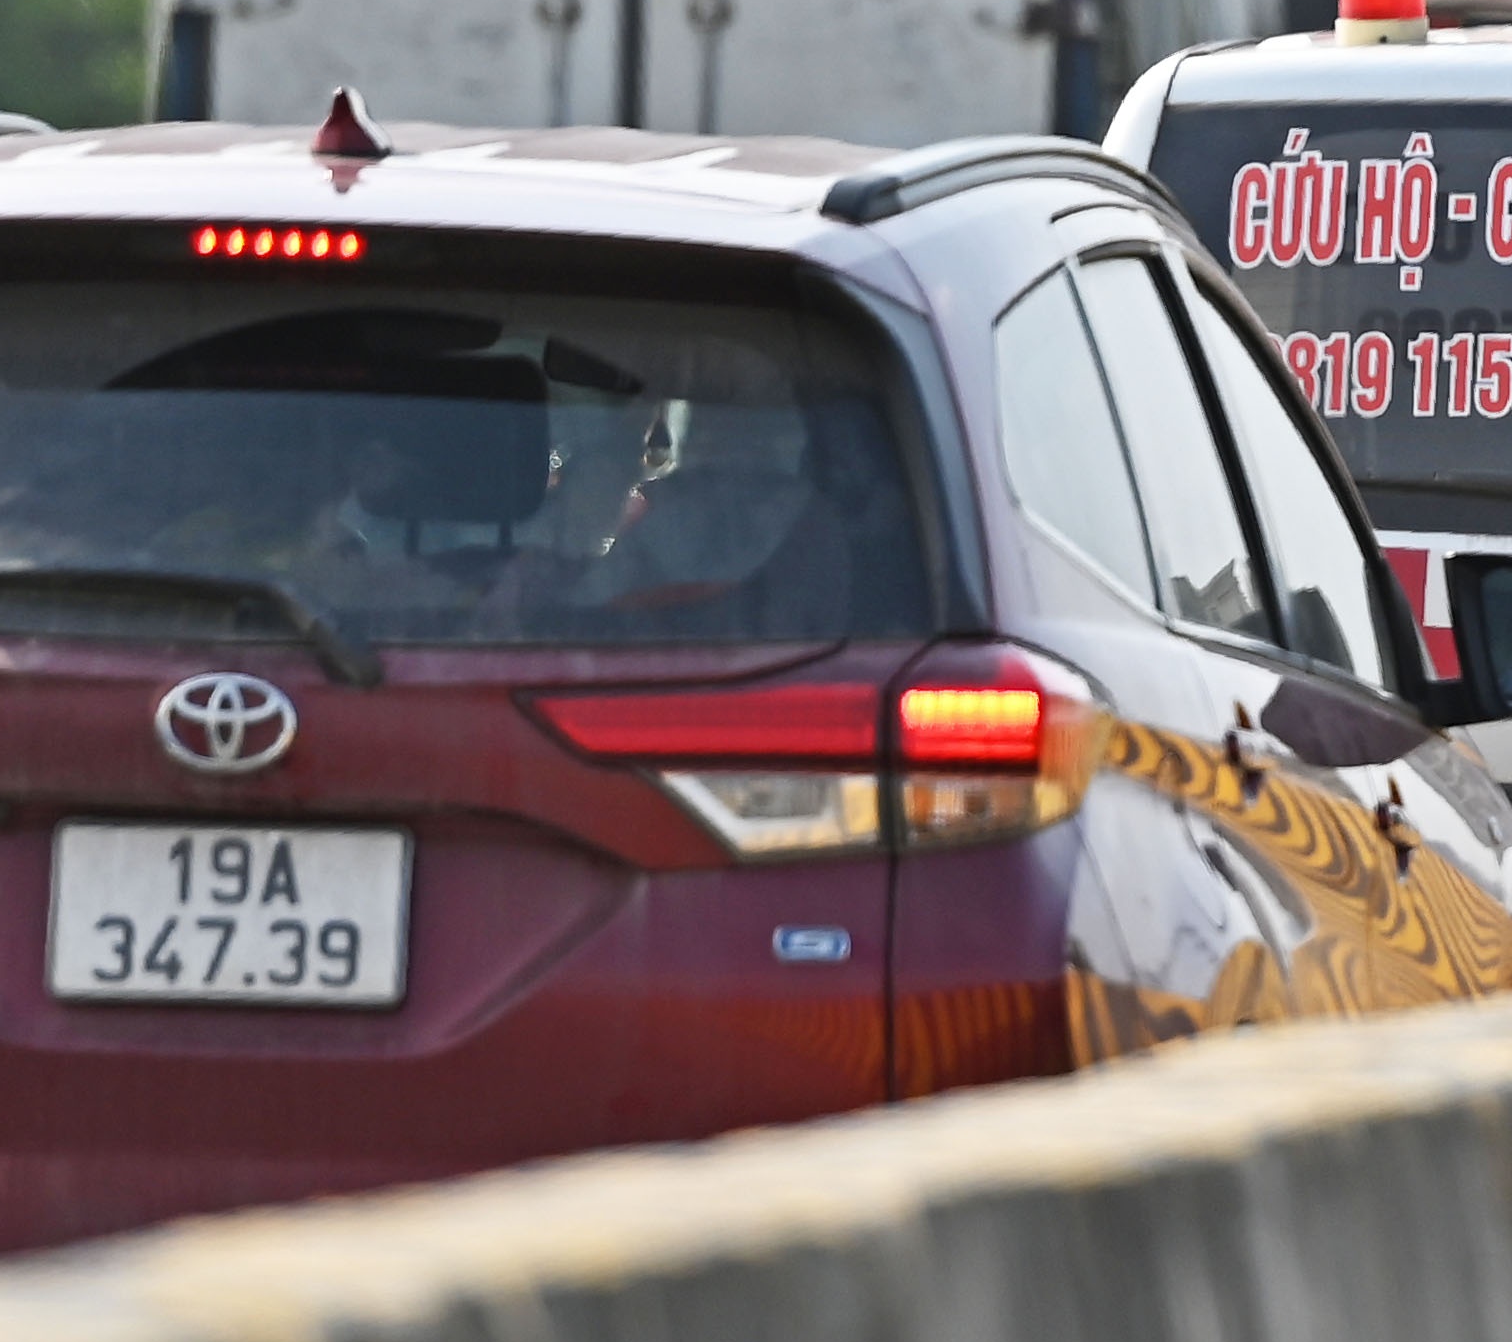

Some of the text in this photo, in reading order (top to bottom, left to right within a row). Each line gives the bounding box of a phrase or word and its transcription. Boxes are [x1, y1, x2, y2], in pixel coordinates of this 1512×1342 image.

[1229, 126, 1348, 269] CỨU
[1354, 131, 1437, 291] HỘ
[1448, 192, 1477, 221] -
[1265, 331, 1394, 419] 819
[170, 836, 299, 905] 19A
[92, 915, 361, 987] 347.39
